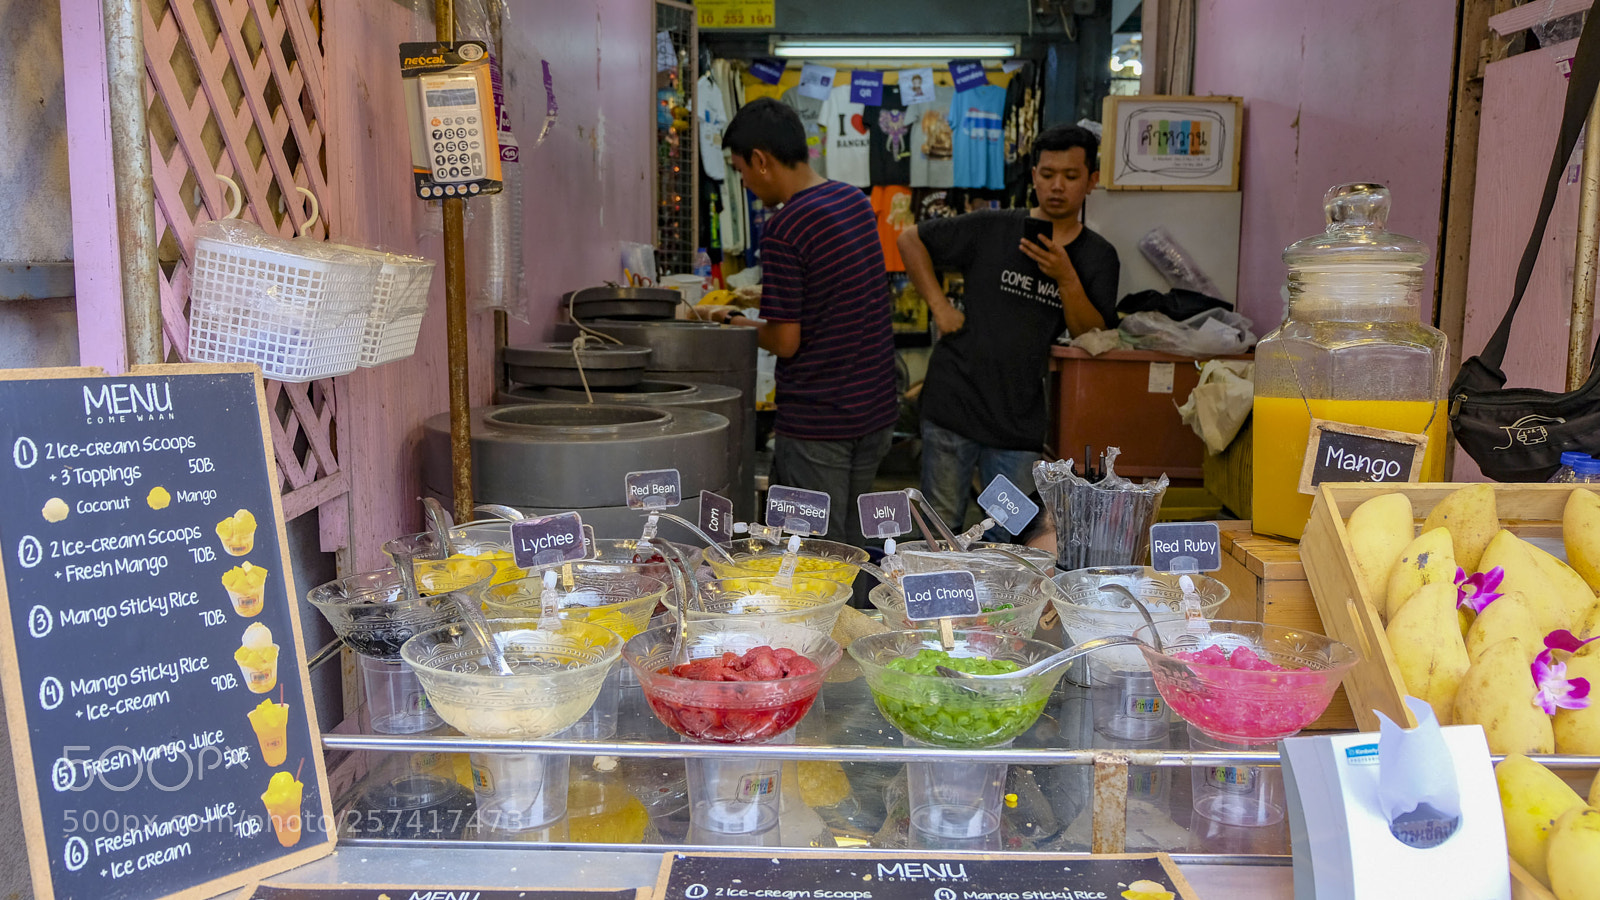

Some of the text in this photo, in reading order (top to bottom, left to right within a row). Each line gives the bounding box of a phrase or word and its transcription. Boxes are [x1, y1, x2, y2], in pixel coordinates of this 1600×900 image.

[838, 113, 846, 136] I
[837, 139, 870, 148] BANGK
[1001, 270, 1034, 291] COME
[83, 382, 173, 415] MENU
[87, 413, 175, 425] COME WAAN
[44, 442, 56, 460] 2
[143, 435, 197, 454] Scoops
[61, 469, 71, 485] 3
[72, 465, 142, 487] Toppings
[188, 457, 216, 475] 50B.
[1325, 446, 1401, 483] Mango
[176, 488, 217, 507] Mango
[630, 483, 676, 496] Red Bean
[76, 496, 132, 515] Coconut
[770, 500, 826, 519] Palm Seed
[873, 505, 896, 521] Jelly
[997, 490, 1020, 516] Oreo
[708, 508, 720, 532] Corn
[50, 541, 60, 558] 2
[148, 525, 202, 546] Scoops
[521, 531, 574, 553] Lychee
[1154, 538, 1216, 556] Red Ruby
[65, 559, 114, 583] Fresh
[115, 554, 169, 576] Mango
[188, 546, 217, 565] 70B.
[906, 586, 975, 603] Lod Chong
[60, 604, 117, 627] Mango
[119, 594, 169, 617] Sticky
[169, 591, 200, 609] Rice
[199, 609, 228, 628] 70B.
[70, 673, 128, 697] Mango
[130, 663, 179, 685] Sticky
[180, 655, 210, 674] Rice
[86, 689, 170, 721] Ice-cream
[210, 673, 239, 692] 90B.
[82, 754, 132, 779] Fresh
[132, 739, 186, 764] Mango
[189, 729, 225, 750] Juice
[223, 747, 251, 769] 50B.
[95, 831, 144, 857] Fresh
[145, 812, 198, 840] Mango
[201, 800, 237, 821] Juice
[233, 818, 262, 840] 70B.
[110, 860, 135, 879] Ice
[877, 863, 967, 878] MENU
[963, 890, 1019, 900] Mango
[1022, 890, 1072, 900] Sticky
[1073, 890, 1108, 899] Rice
